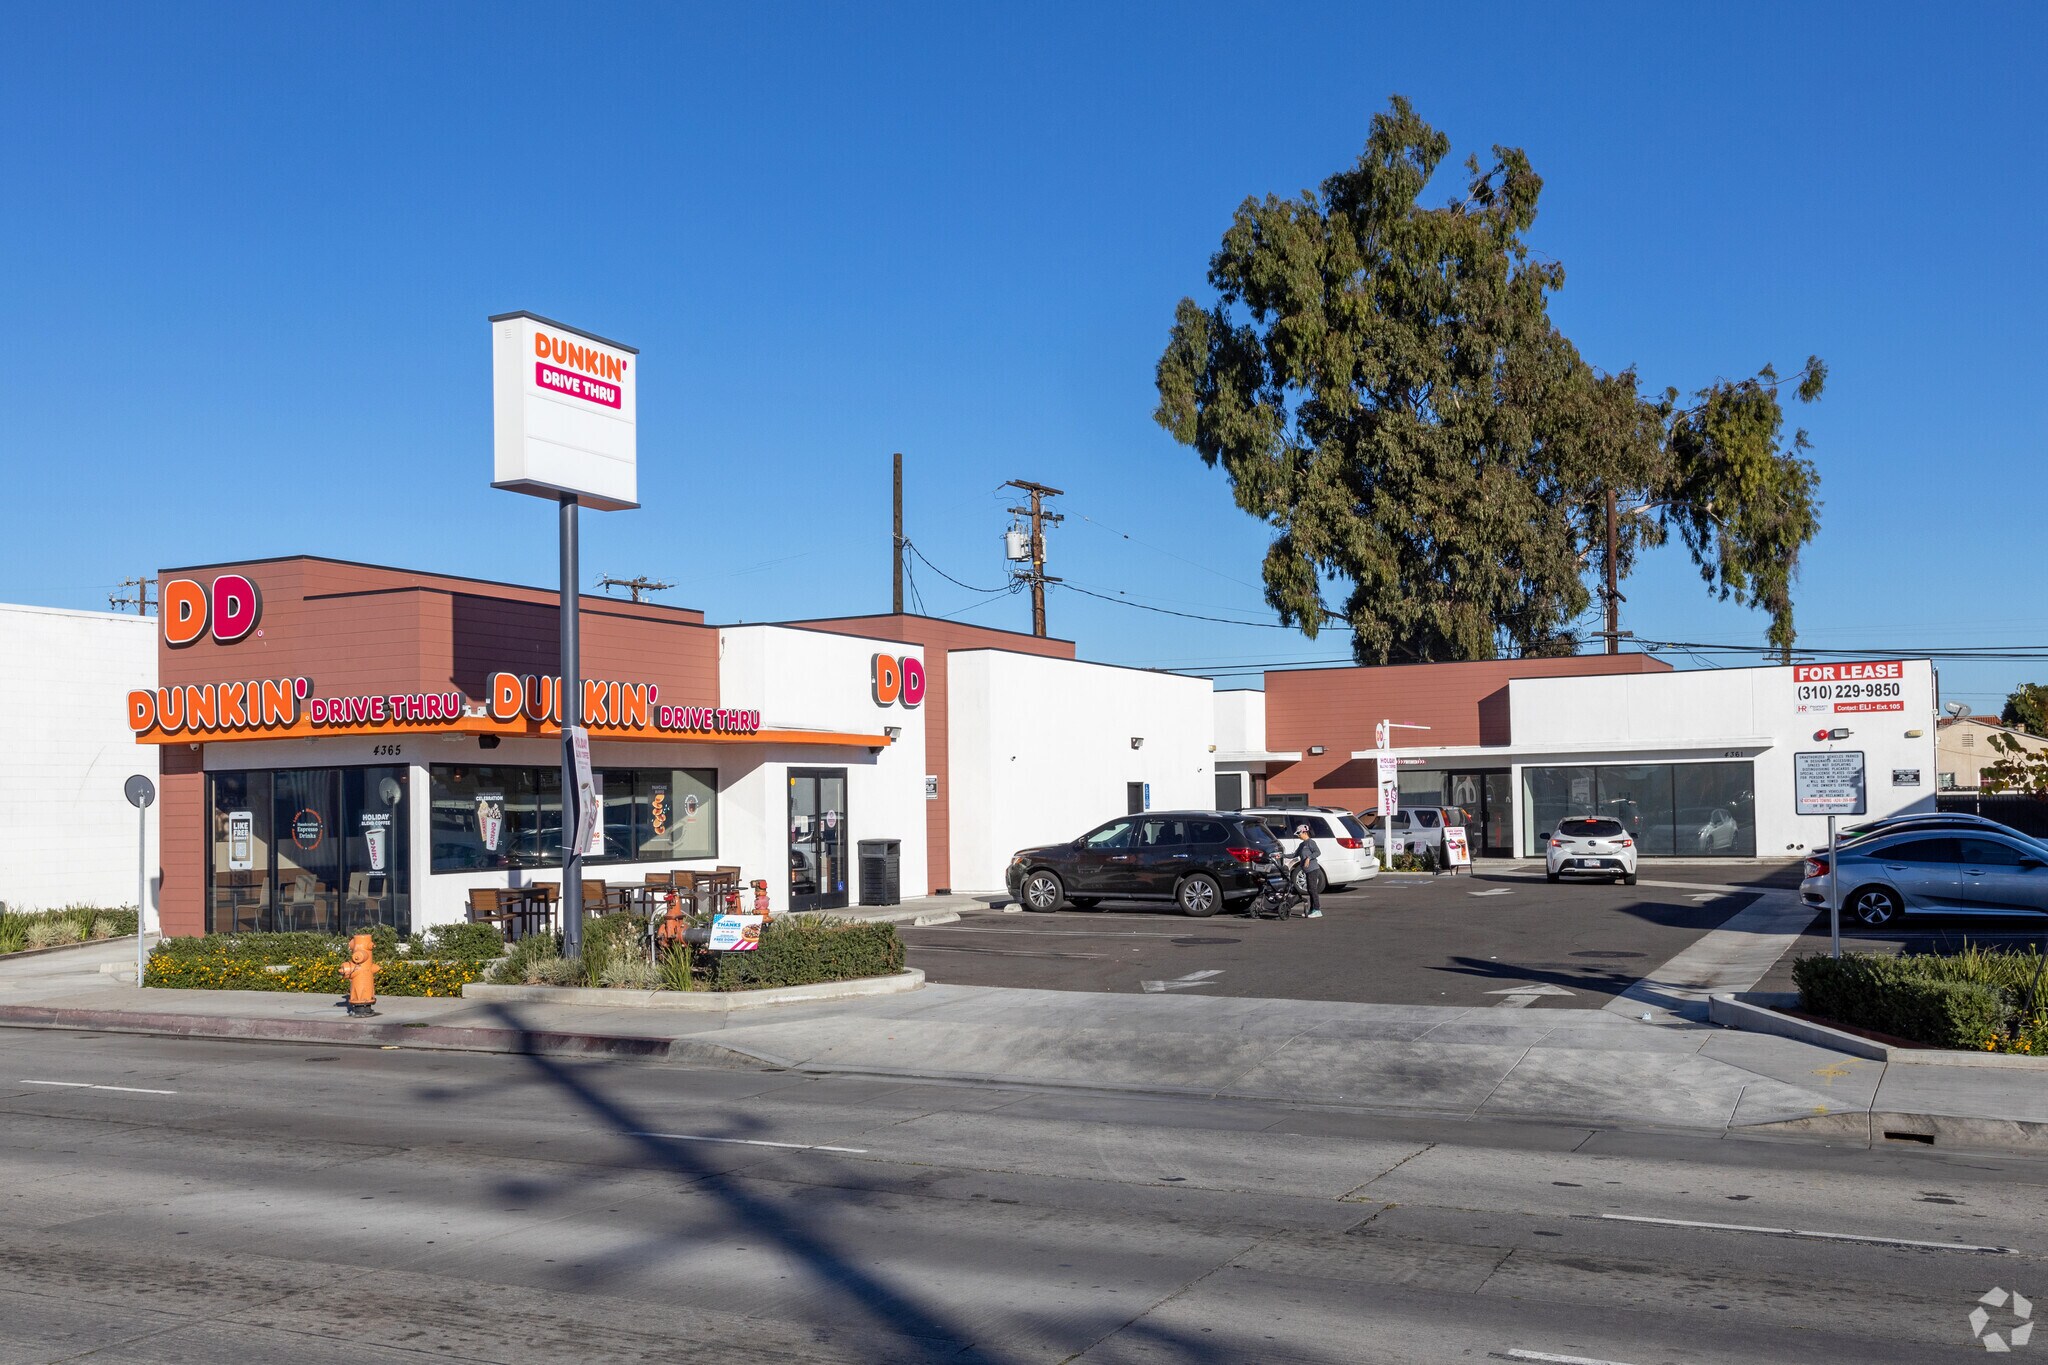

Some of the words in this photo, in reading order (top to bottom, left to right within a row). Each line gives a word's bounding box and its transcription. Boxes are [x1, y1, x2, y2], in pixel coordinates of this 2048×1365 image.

[535, 332, 627, 383] DUNKIN'
[542, 369, 580, 392] DRIVE
[582, 381, 615, 403] THRU
[164, 574, 258, 645] DD
[876, 652, 926, 706] DD
[1799, 667, 1835, 681] FOR
[1840, 663, 1899, 679] LEASE
[126, 677, 308, 732] DUNKIN'
[311, 695, 385, 724] DRIVE
[389, 692, 461, 721] THRU
[493, 672, 659, 727] DUKIN'
[660, 705, 713, 730] DRIVE
[715, 708, 761, 731] THRU
[1797, 685, 1832, 701] (310)
[1835, 682, 1900, 699] 229-9850
[1837, 704, 1859, 712] Contact:
[1859, 703, 1872, 711] ELI
[1876, 703, 1888, 711] Ext.
[373, 744, 402, 756] 4365
[362, 813, 390, 821] HOLIDAY
[233, 829, 249, 837] FREE
